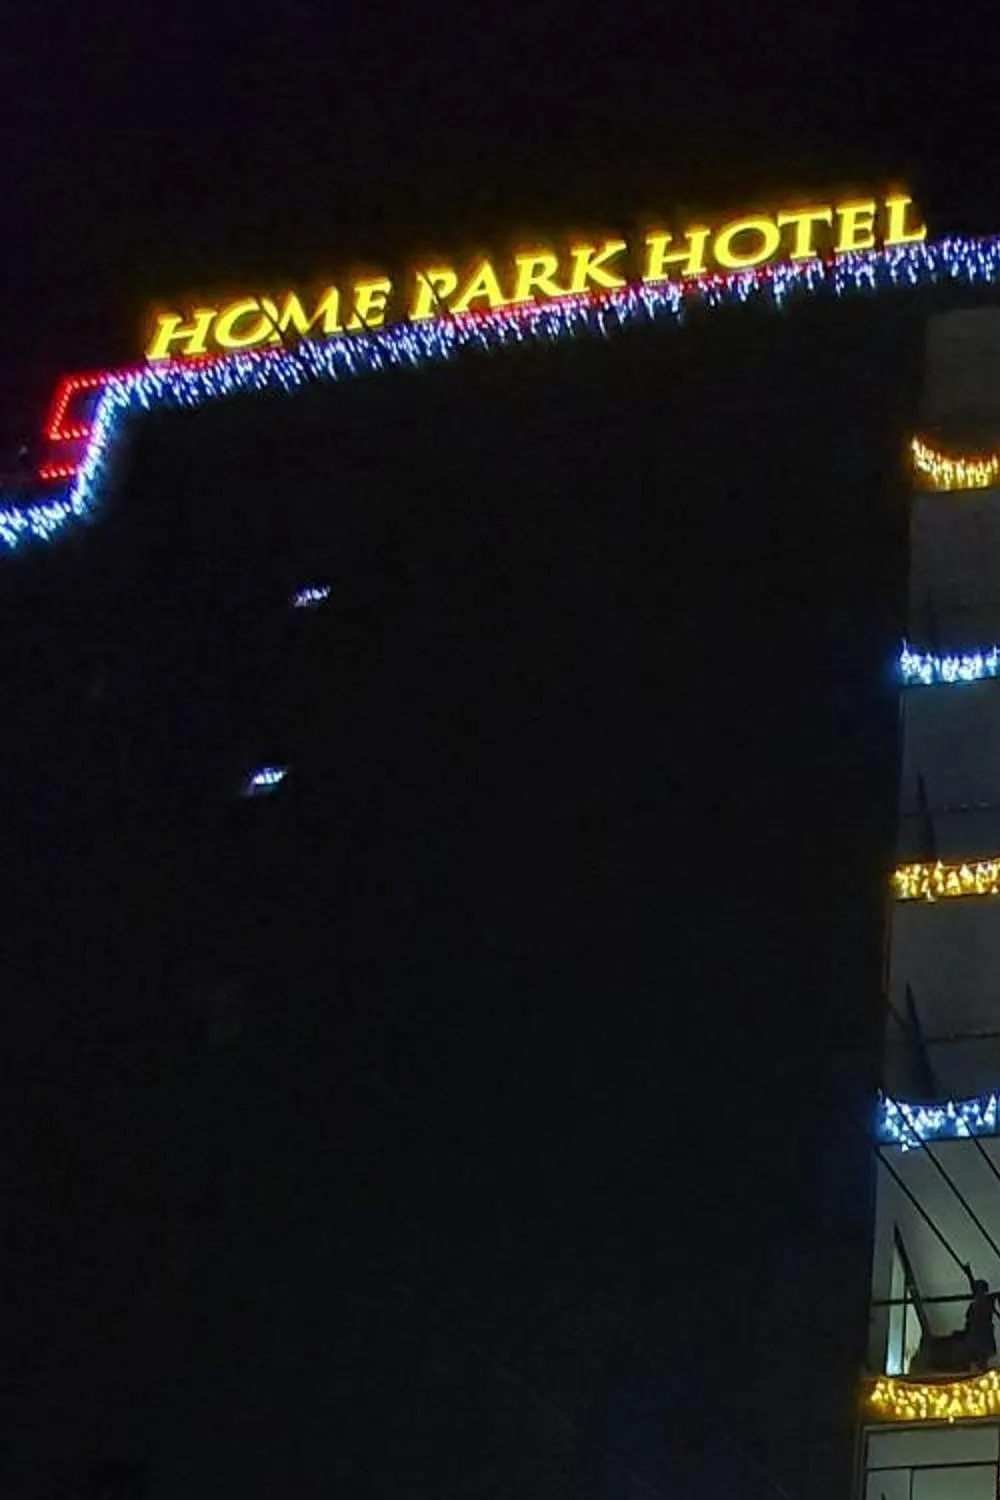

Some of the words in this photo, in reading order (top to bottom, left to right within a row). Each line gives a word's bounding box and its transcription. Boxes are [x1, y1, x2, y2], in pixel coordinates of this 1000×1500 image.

[145, 277, 393, 362] HOME
[409, 240, 628, 322] PARK
[641, 195, 928, 286] HOTEL
